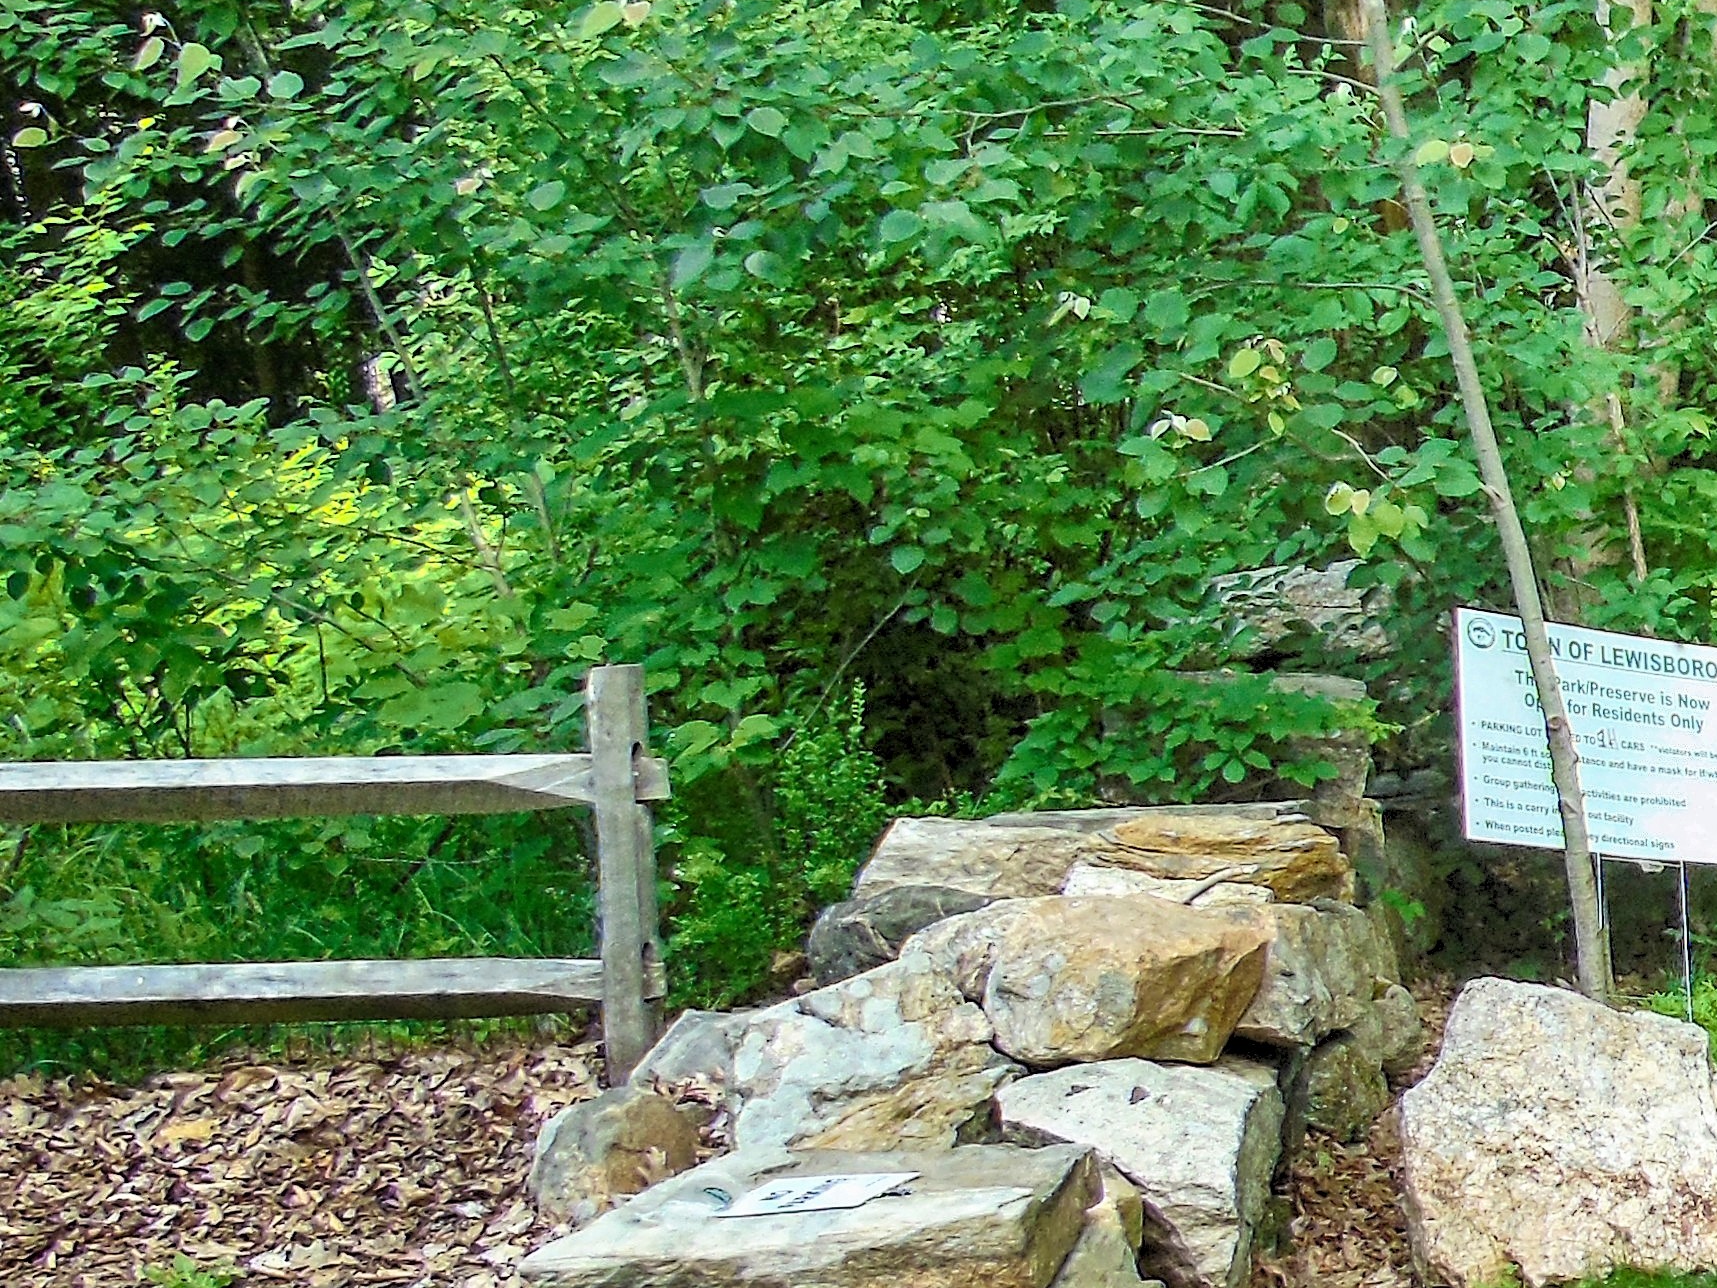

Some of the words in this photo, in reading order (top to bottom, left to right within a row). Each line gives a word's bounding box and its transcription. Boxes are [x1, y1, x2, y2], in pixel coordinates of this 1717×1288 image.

[1502, 629, 1561, 657] TON
[1568, 641, 1594, 661] OF
[1601, 645, 1717, 679] LEWISBORO
[1660, 690, 1673, 706] is
[1678, 693, 1711, 710] Now
[1567, 699, 1587, 714] for
[1592, 702, 1665, 726] Residents
[1671, 713, 1704, 733] Only
[1481, 720, 1522, 734] PARKING
[1525, 726, 1543, 737] LOT
[1584, 735, 1596, 745] TO
[1621, 740, 1645, 751] CARS
[1482, 741, 1520, 754] Maintain
[1523, 747, 1528, 756] 6
[1531, 748, 1538, 757] ft
[1580, 756, 1606, 767] tance
[1609, 760, 1625, 769] and
[1627, 761, 1648, 772] have
[1658, 765, 1681, 775] mask
[1684, 767, 1697, 776] for
[1482, 755, 1498, 764] you
[1501, 757, 1532, 768] cannot
[1483, 775, 1511, 788] Group
[1513, 780, 1556, 795] gathering
[1623, 794, 1638, 803] are
[1640, 796, 1687, 807] prohibited
[1484, 797, 1504, 807] This
[1506, 799, 1515, 809] is
[1517, 803, 1523, 811] a
[1525, 804, 1549, 815] carry
[1588, 811, 1601, 820] out
[1604, 812, 1634, 826] facility
[1485, 820, 1511, 830] When
[1513, 824, 1544, 836] posted
[1601, 833, 1648, 847] directional
[1651, 839, 1675, 850] signs
